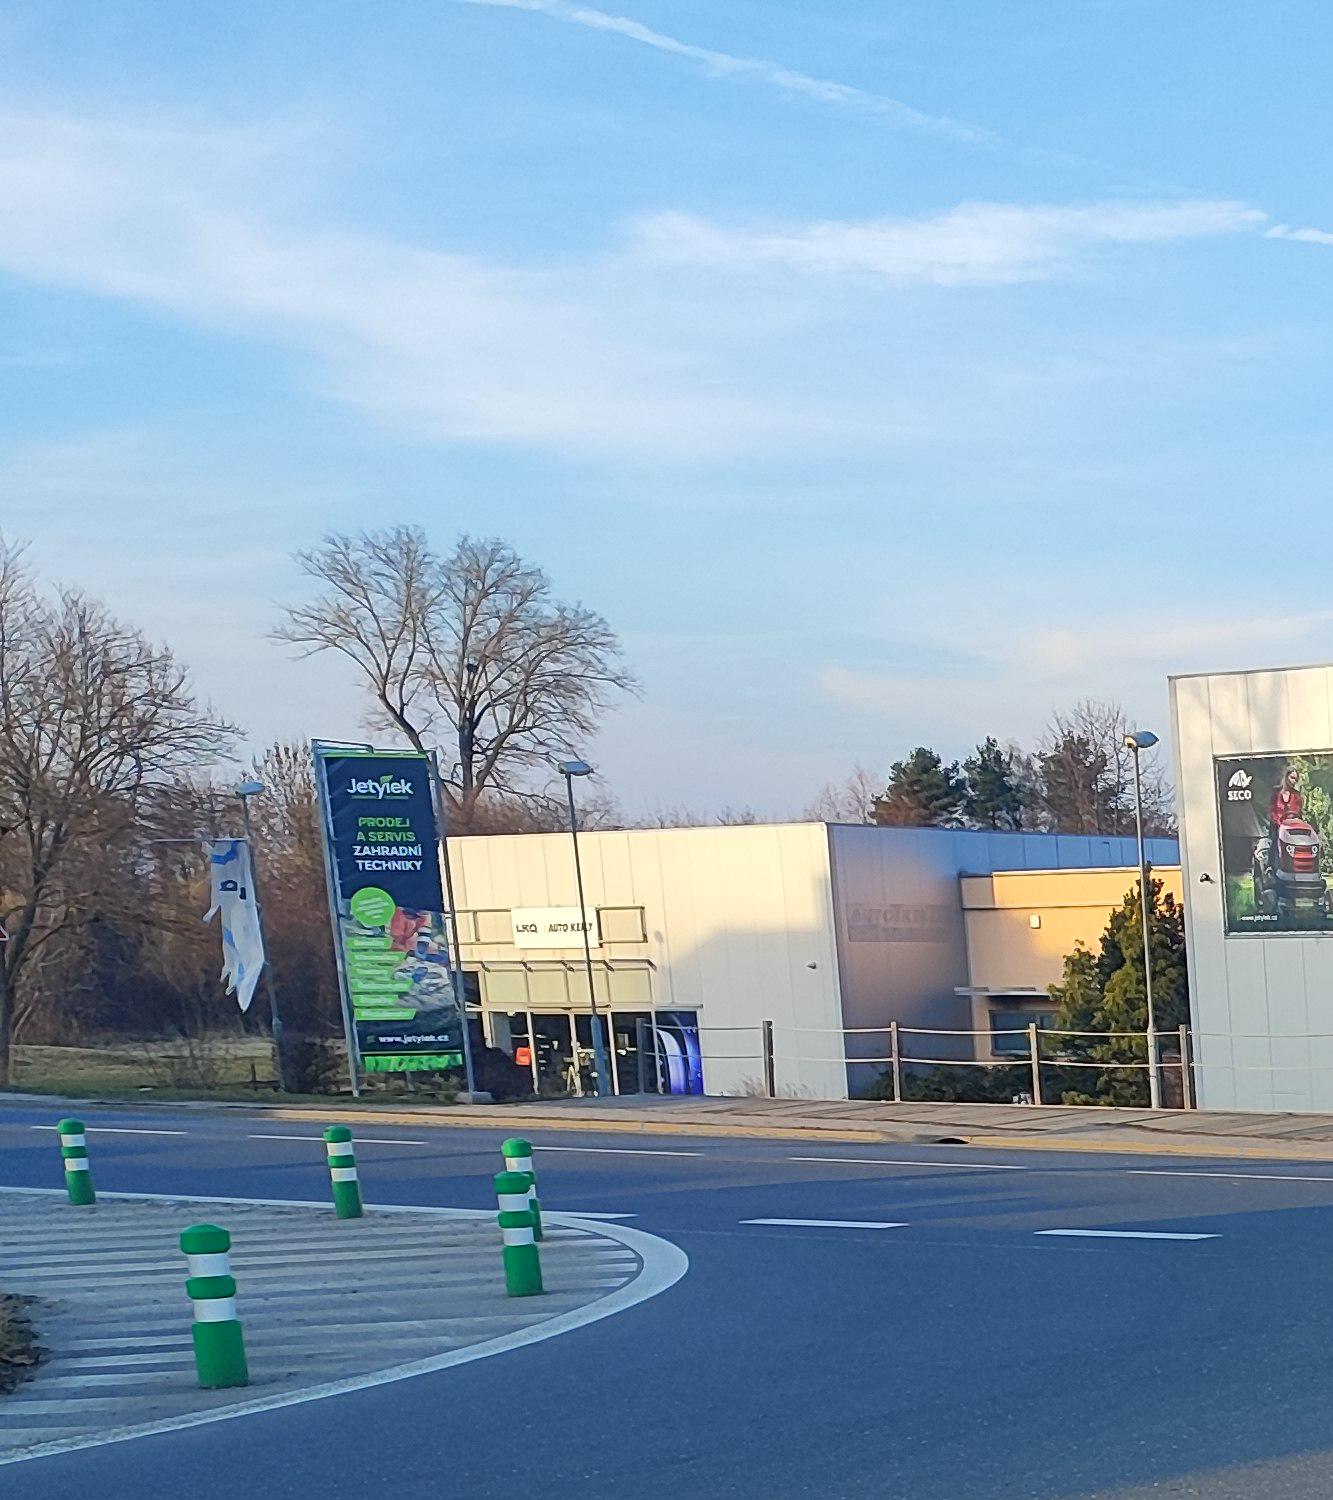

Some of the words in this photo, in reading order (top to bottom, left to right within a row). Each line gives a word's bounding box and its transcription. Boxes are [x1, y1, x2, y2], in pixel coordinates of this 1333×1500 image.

[1227, 790, 1252, 801] SECO
[358, 817, 411, 828] PRODEJ
[356, 831, 366, 842] A
[368, 832, 416, 842] SERVIS
[352, 844, 422, 857] ZAHRADNÍ
[355, 860, 423, 871] TECHNIKY
